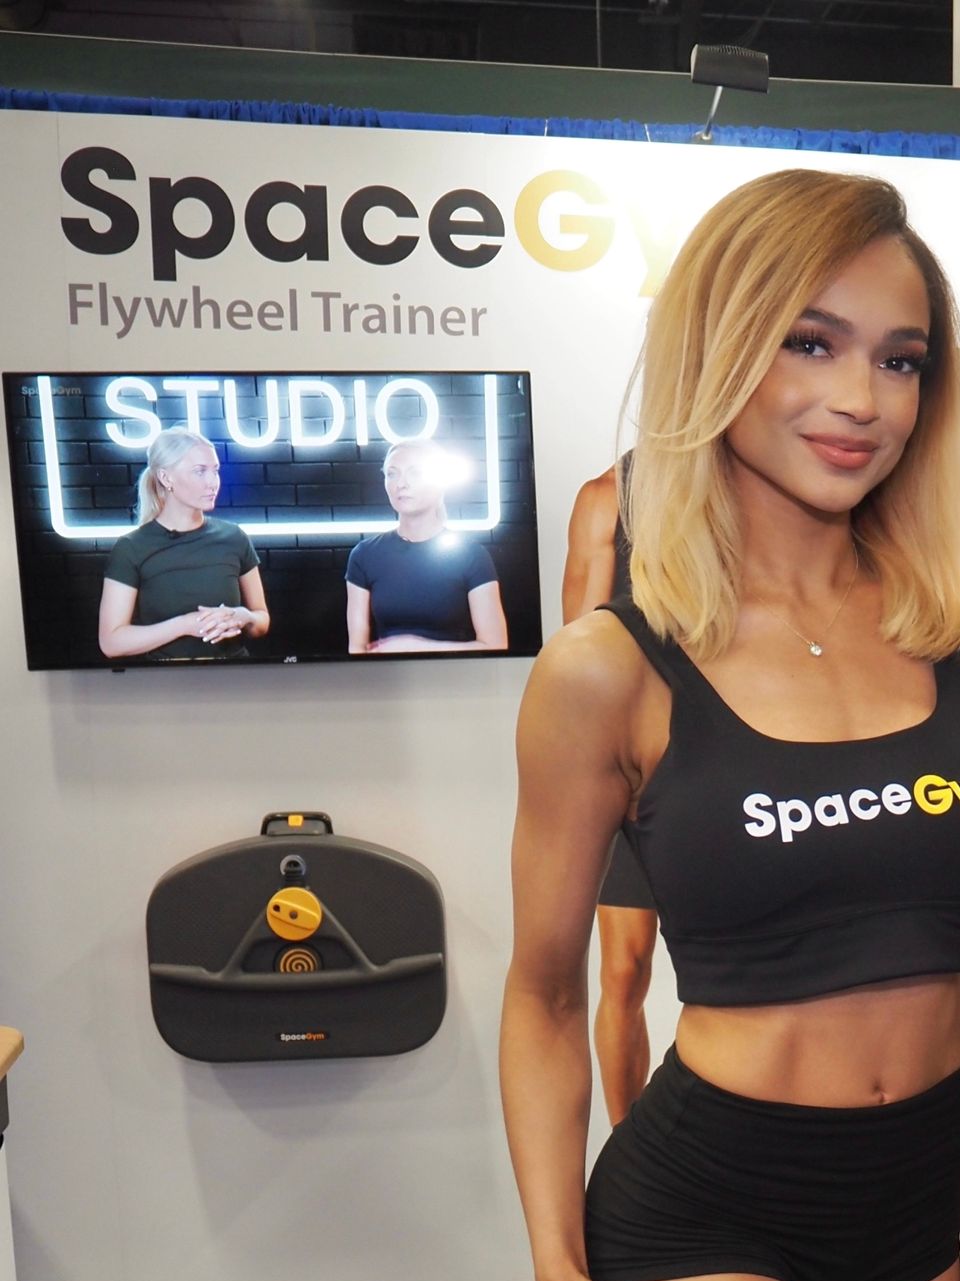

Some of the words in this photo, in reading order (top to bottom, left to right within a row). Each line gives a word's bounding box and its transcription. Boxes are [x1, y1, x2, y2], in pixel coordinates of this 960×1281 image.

[60, 146, 680, 298] SpaceGy
[68, 282, 299, 339] Flywheel
[311, 291, 487, 337] Trainer
[21, 386, 82, 397] SpGym
[105, 377, 439, 448] STUDIO
[280, 1033, 325, 1041] SpaceGym
